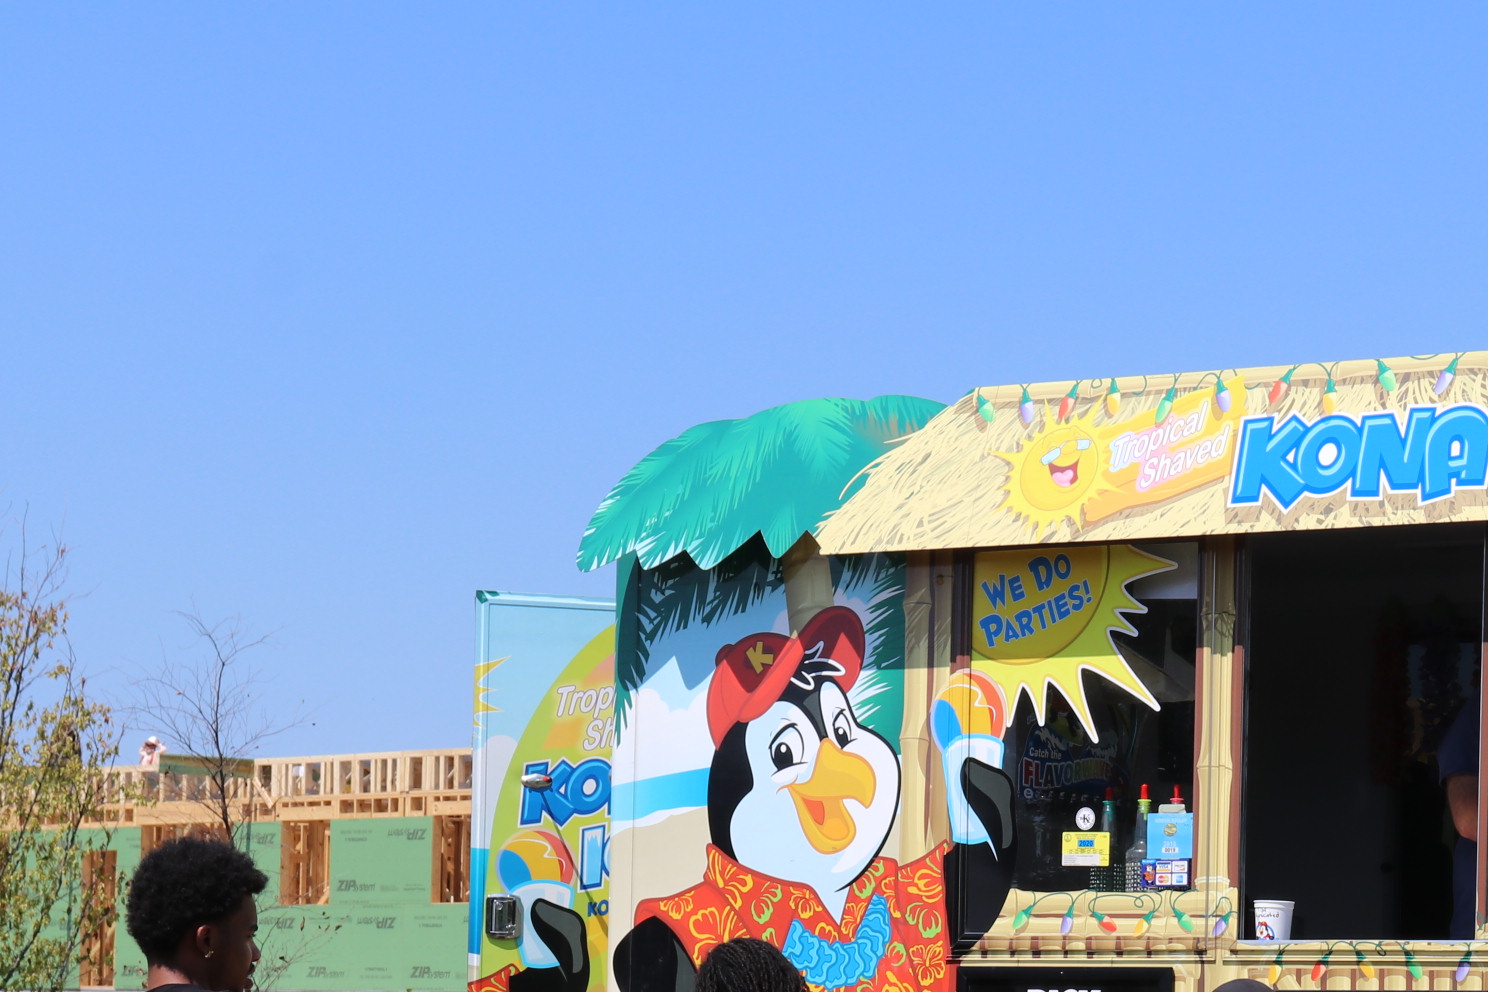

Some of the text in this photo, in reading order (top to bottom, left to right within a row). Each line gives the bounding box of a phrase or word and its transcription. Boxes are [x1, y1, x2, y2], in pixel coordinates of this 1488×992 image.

[1113, 400, 1208, 467] Tropical
[1140, 425, 1230, 489] Shaved
[978, 579, 1093, 648] PARTIES!
[981, 553, 1072, 610] WE DO
[745, 642, 774, 674] K
[1029, 747, 1062, 760] Catch the
[518, 757, 611, 828] KO
